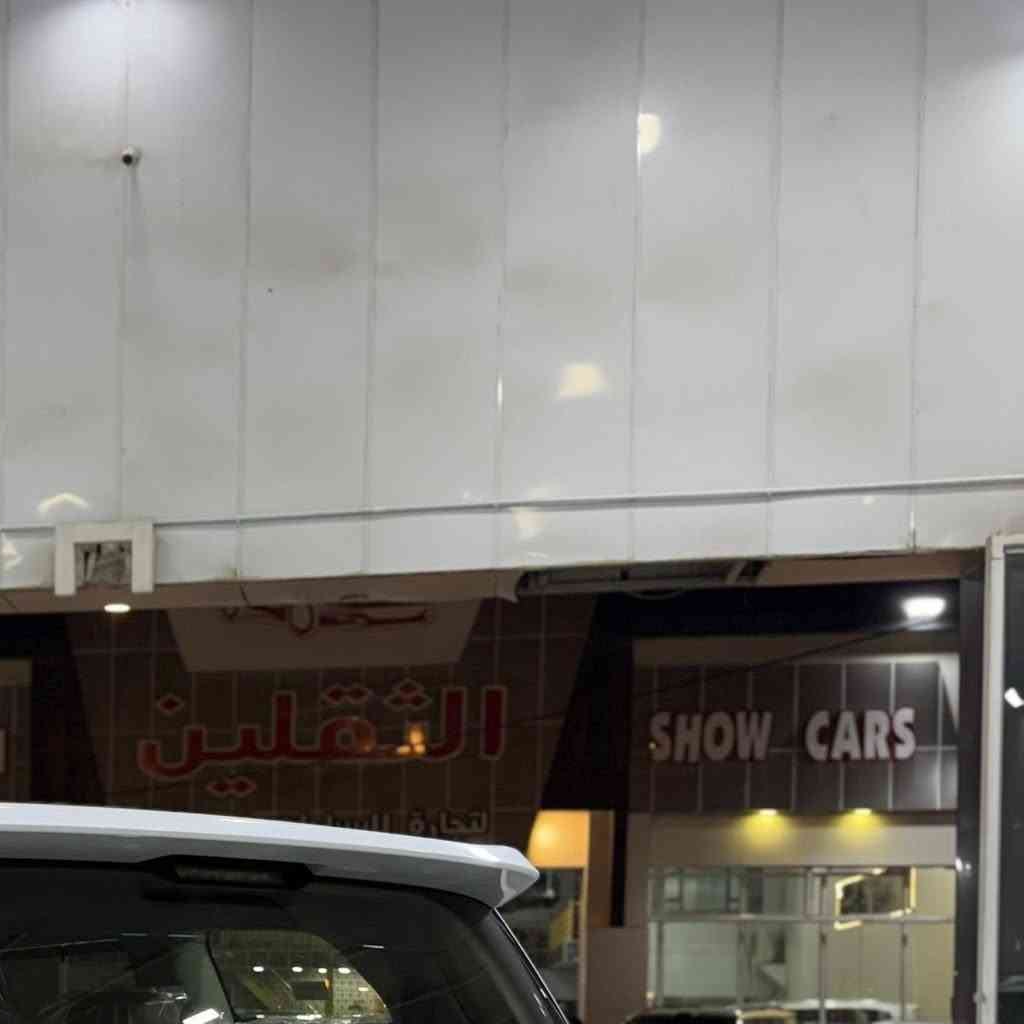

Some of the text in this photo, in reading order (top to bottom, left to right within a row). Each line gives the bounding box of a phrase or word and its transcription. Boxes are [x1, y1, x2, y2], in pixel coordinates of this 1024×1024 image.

[137, 679, 507, 797] الثقلين
[650, 706, 916, 762] SHOW CARS
